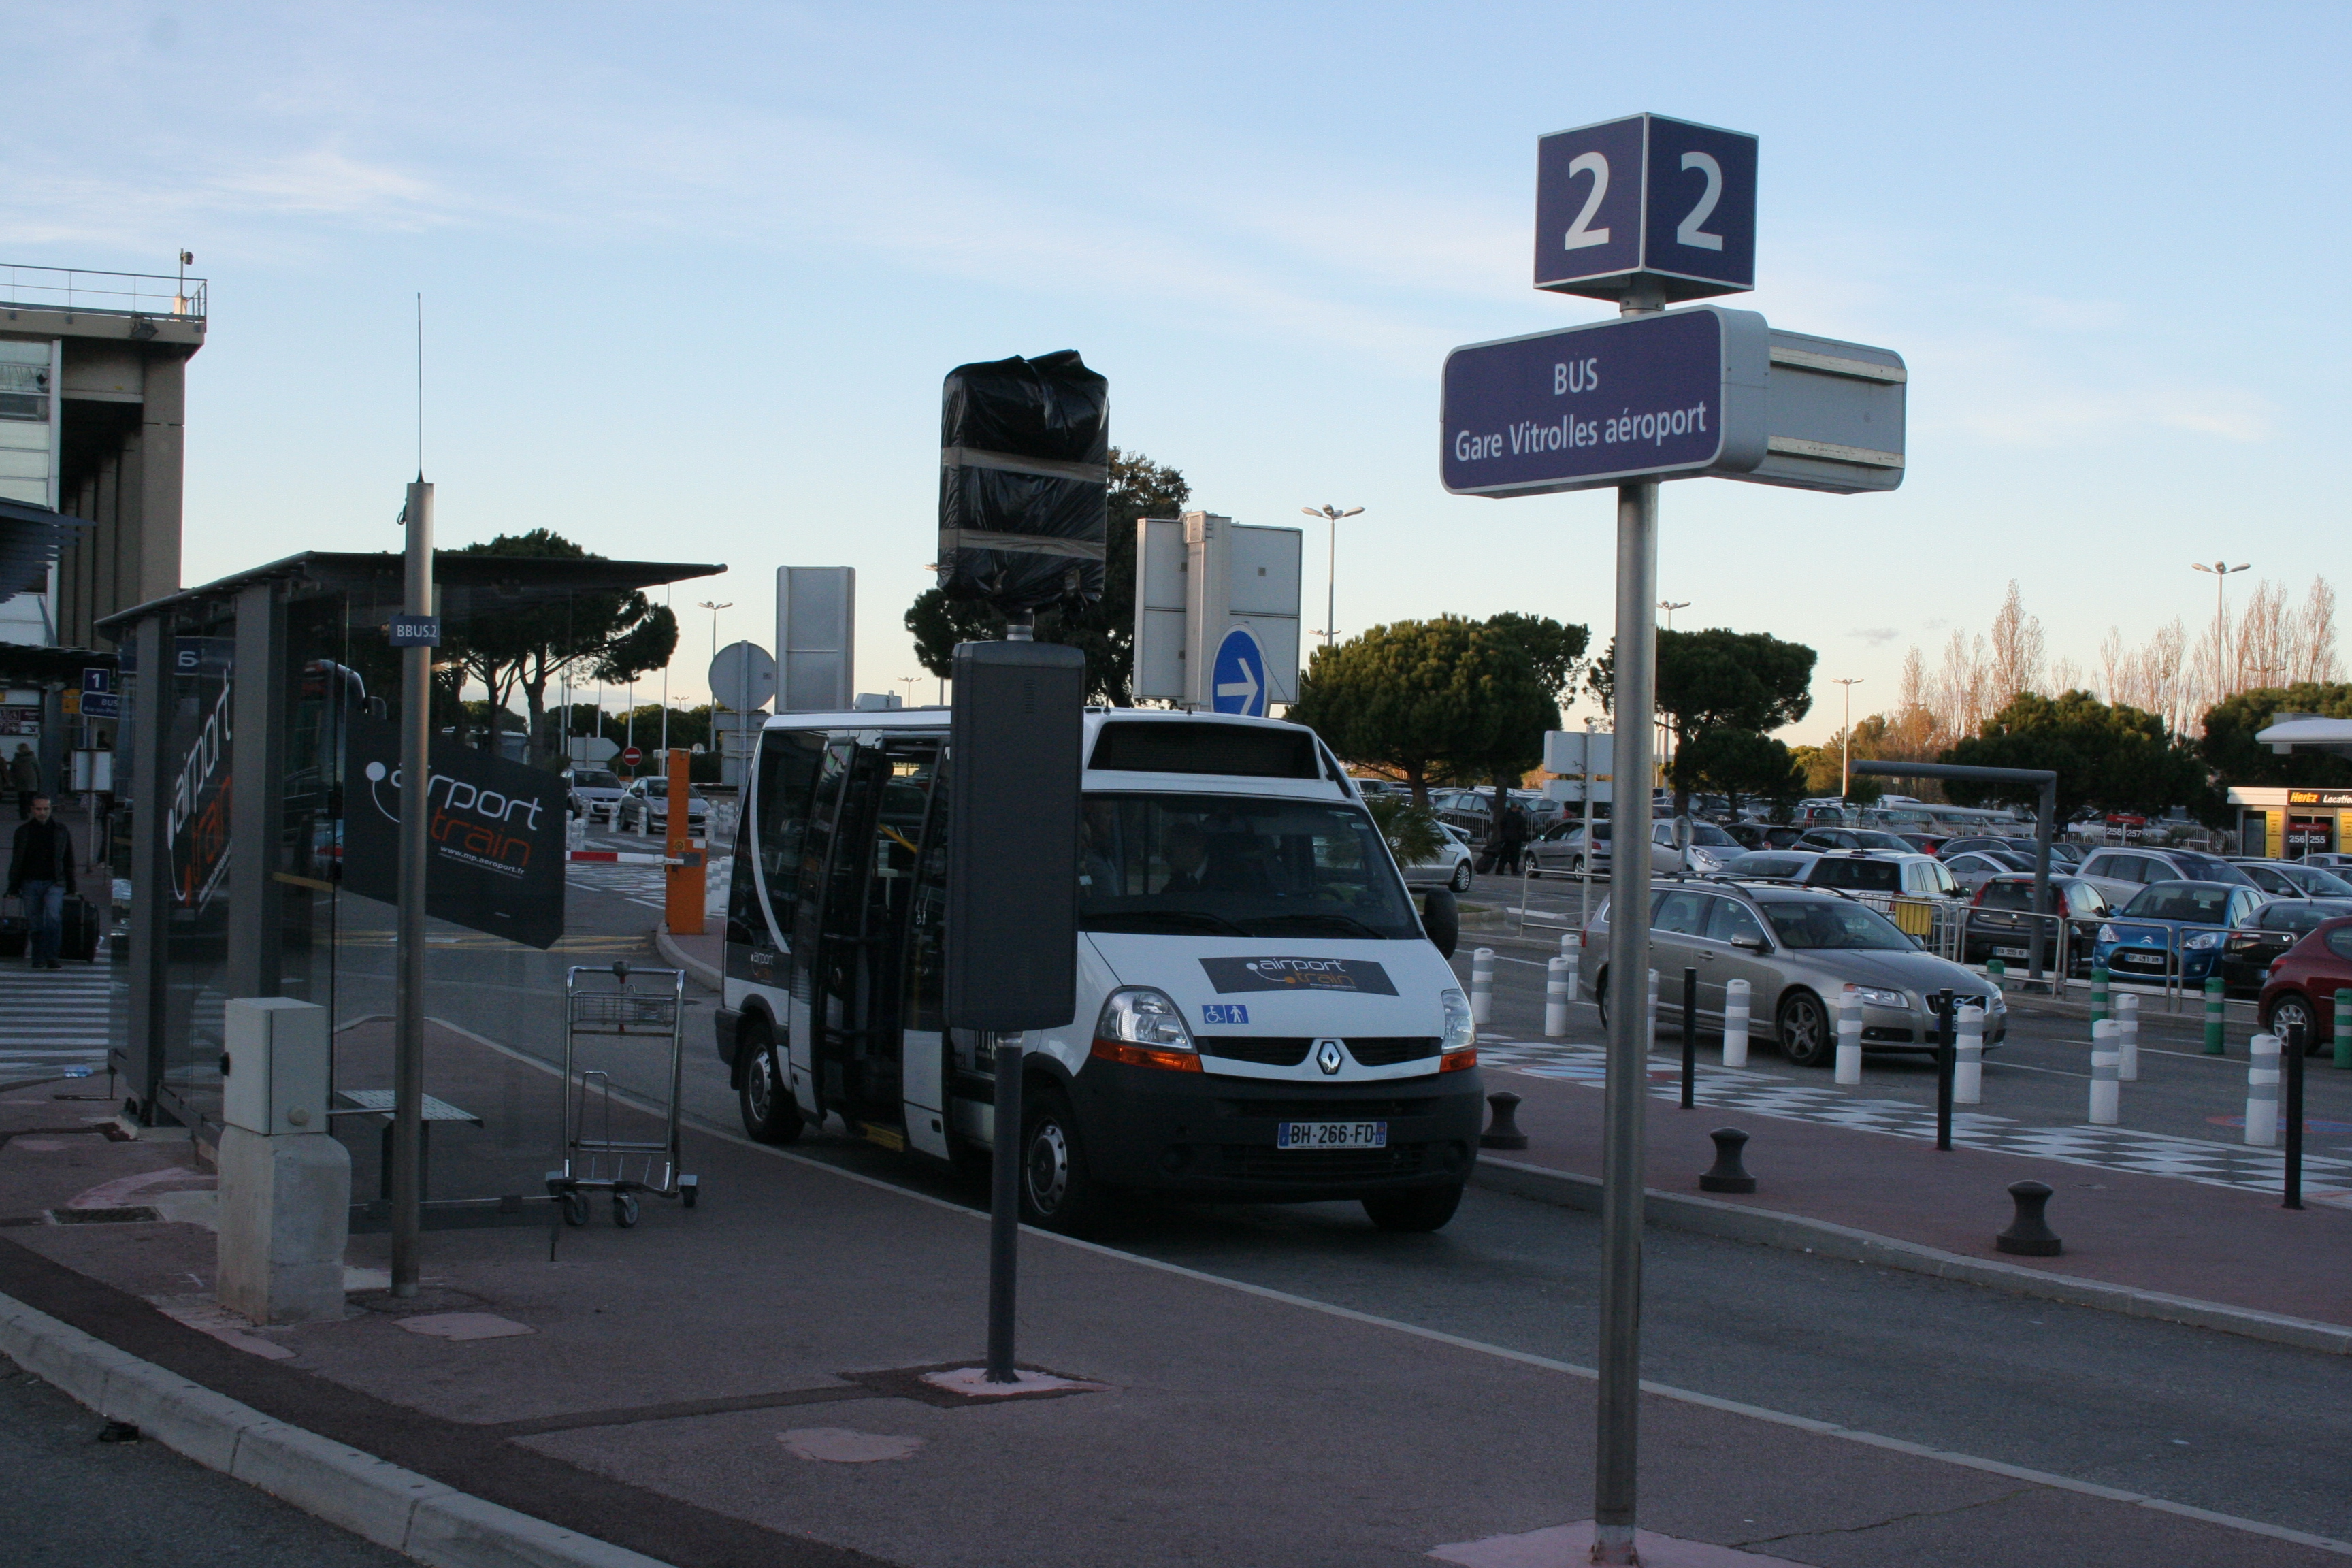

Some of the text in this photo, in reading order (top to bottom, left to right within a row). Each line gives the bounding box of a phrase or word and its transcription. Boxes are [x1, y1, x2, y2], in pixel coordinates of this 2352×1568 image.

[1565, 151, 1610, 251] 2
[1676, 151, 1723, 252] 2
[1554, 357, 1598, 395] BUS
[1455, 401, 1707, 461] Gare Vitrolles aéroport
[91, 673, 100, 688] 1
[2289, 791, 2319, 803] Hertz
[430, 806, 532, 867] train
[2106, 827, 2123, 836] 258
[2126, 829, 2142, 838] 257
[1260, 958, 1346, 973] airport
[1294, 970, 1356, 985] train
[1290, 1124, 1375, 1145] BH-266-FD
